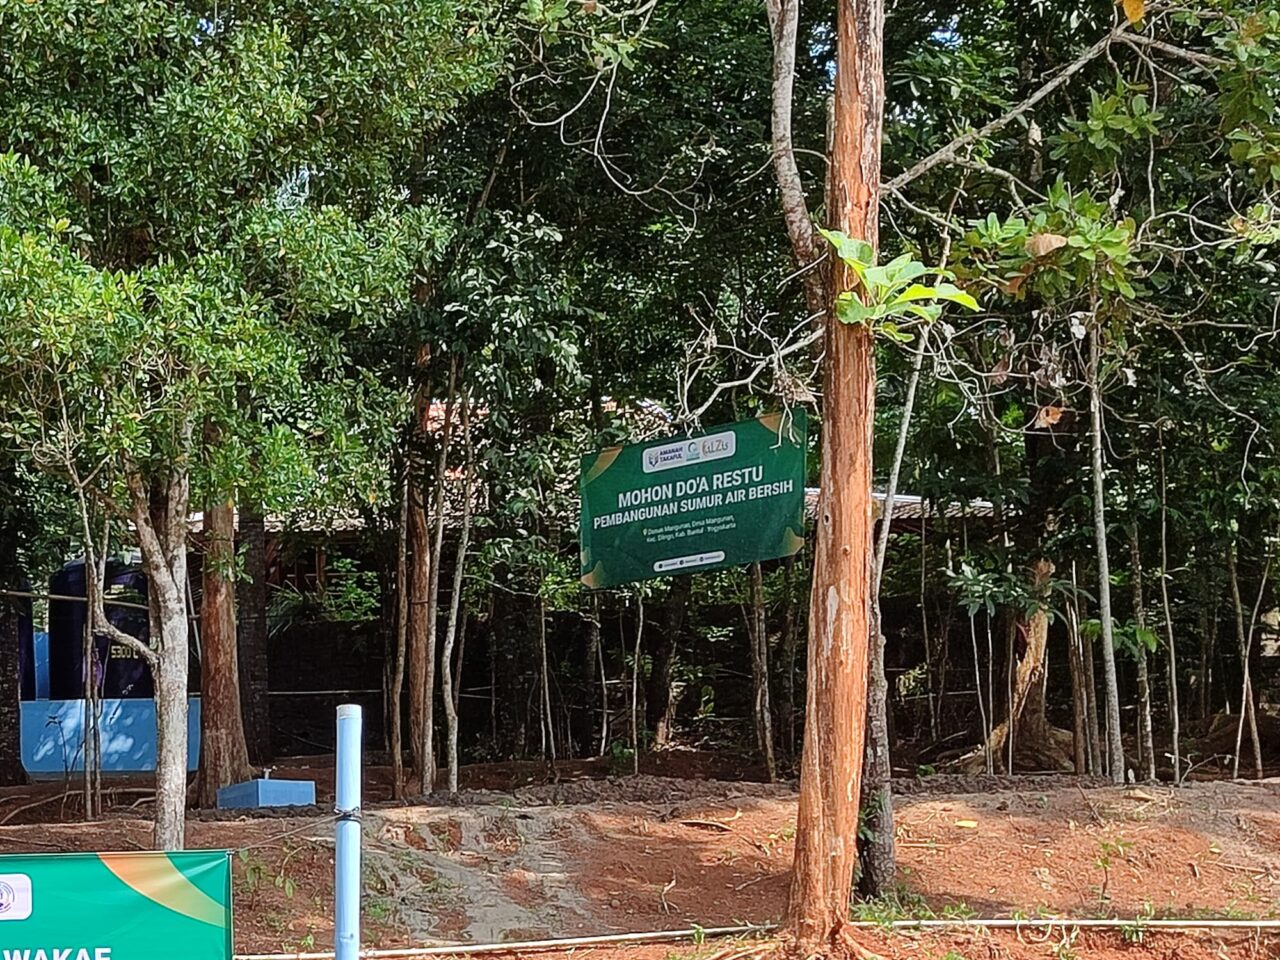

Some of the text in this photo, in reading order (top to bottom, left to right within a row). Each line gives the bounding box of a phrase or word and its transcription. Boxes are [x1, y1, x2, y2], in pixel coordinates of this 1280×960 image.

[593, 479, 793, 529] PEMBANGUNAN SUMUR AIR BERSIH
[618, 465, 763, 508] MOHON DO'A RESTU
[111, 645, 131, 659] 5300
